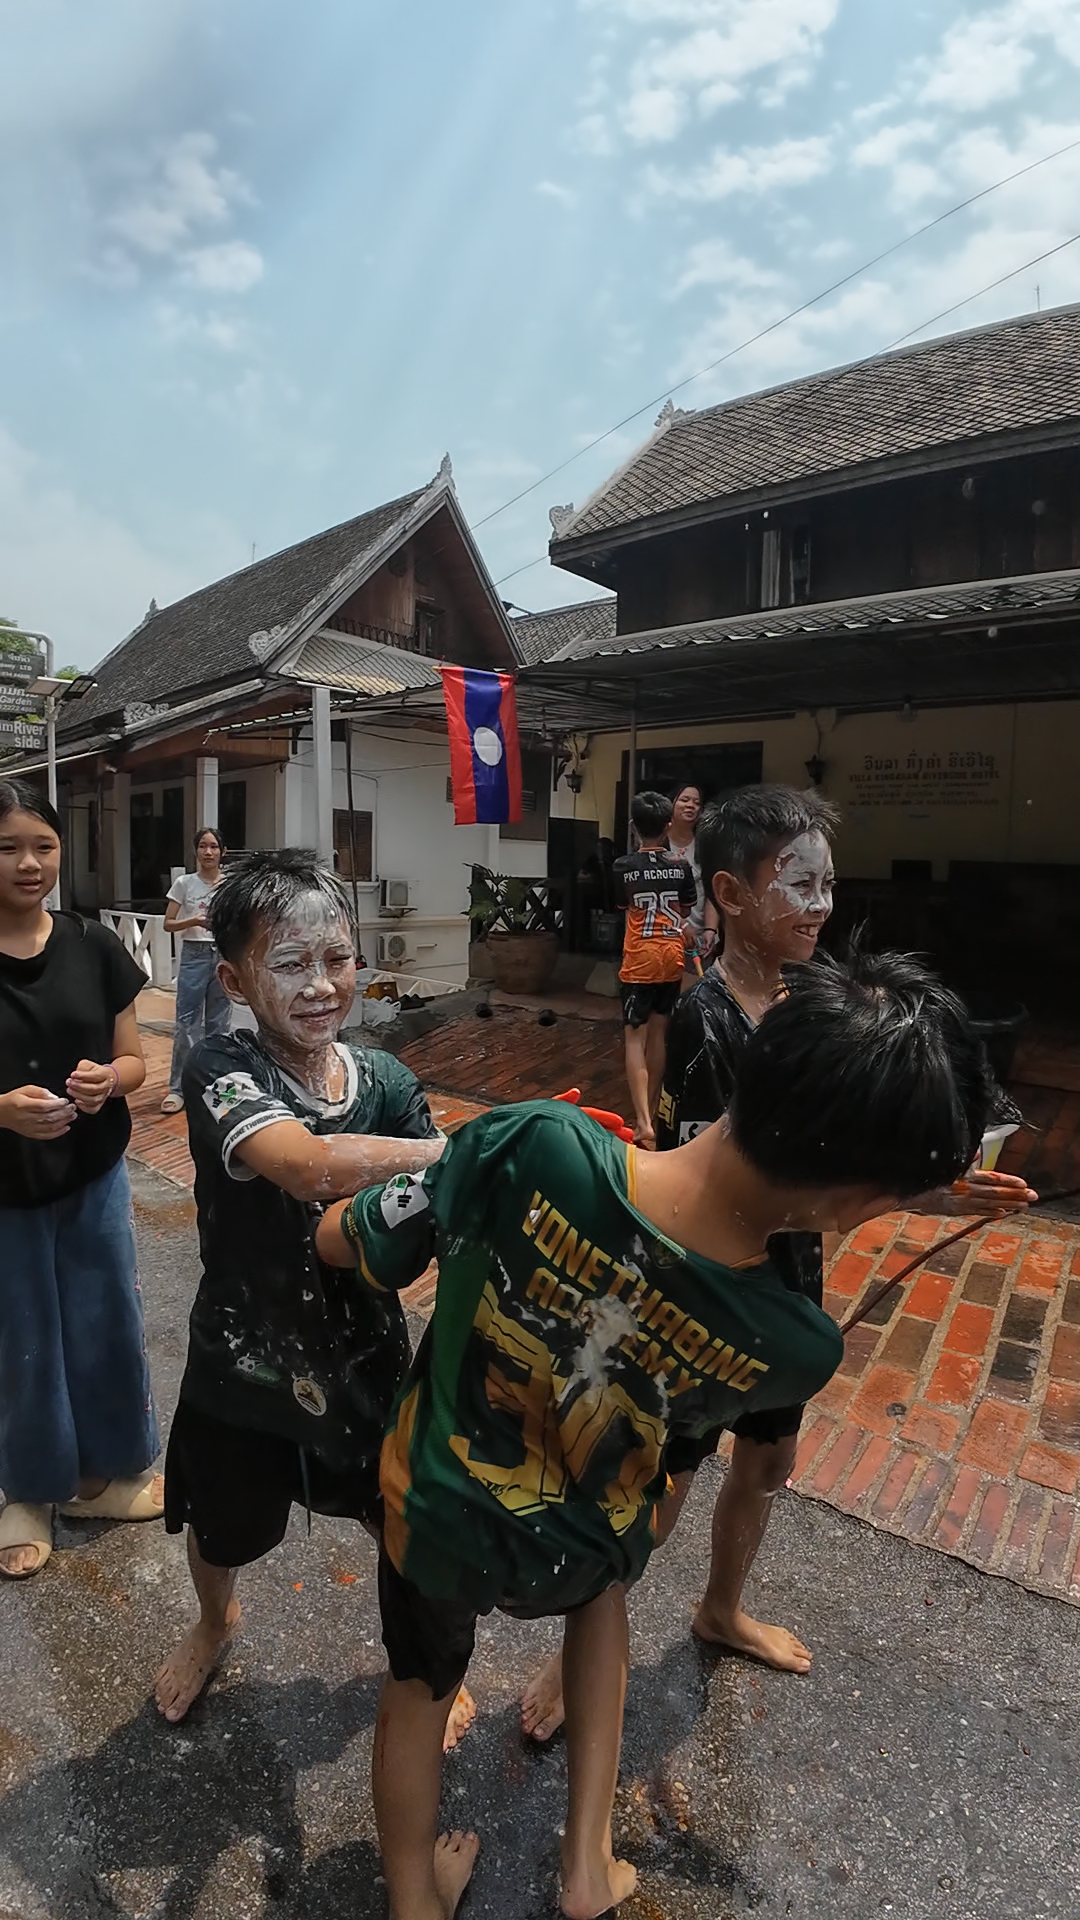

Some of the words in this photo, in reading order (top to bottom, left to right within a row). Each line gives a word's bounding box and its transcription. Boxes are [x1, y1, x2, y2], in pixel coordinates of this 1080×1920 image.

[0, 695, 32, 706] Garden
[14, 735, 41, 749] side
[971, 770, 1000, 779] HOTEL
[623, 870, 640, 883] PKP
[633, 890, 683, 938] 75
